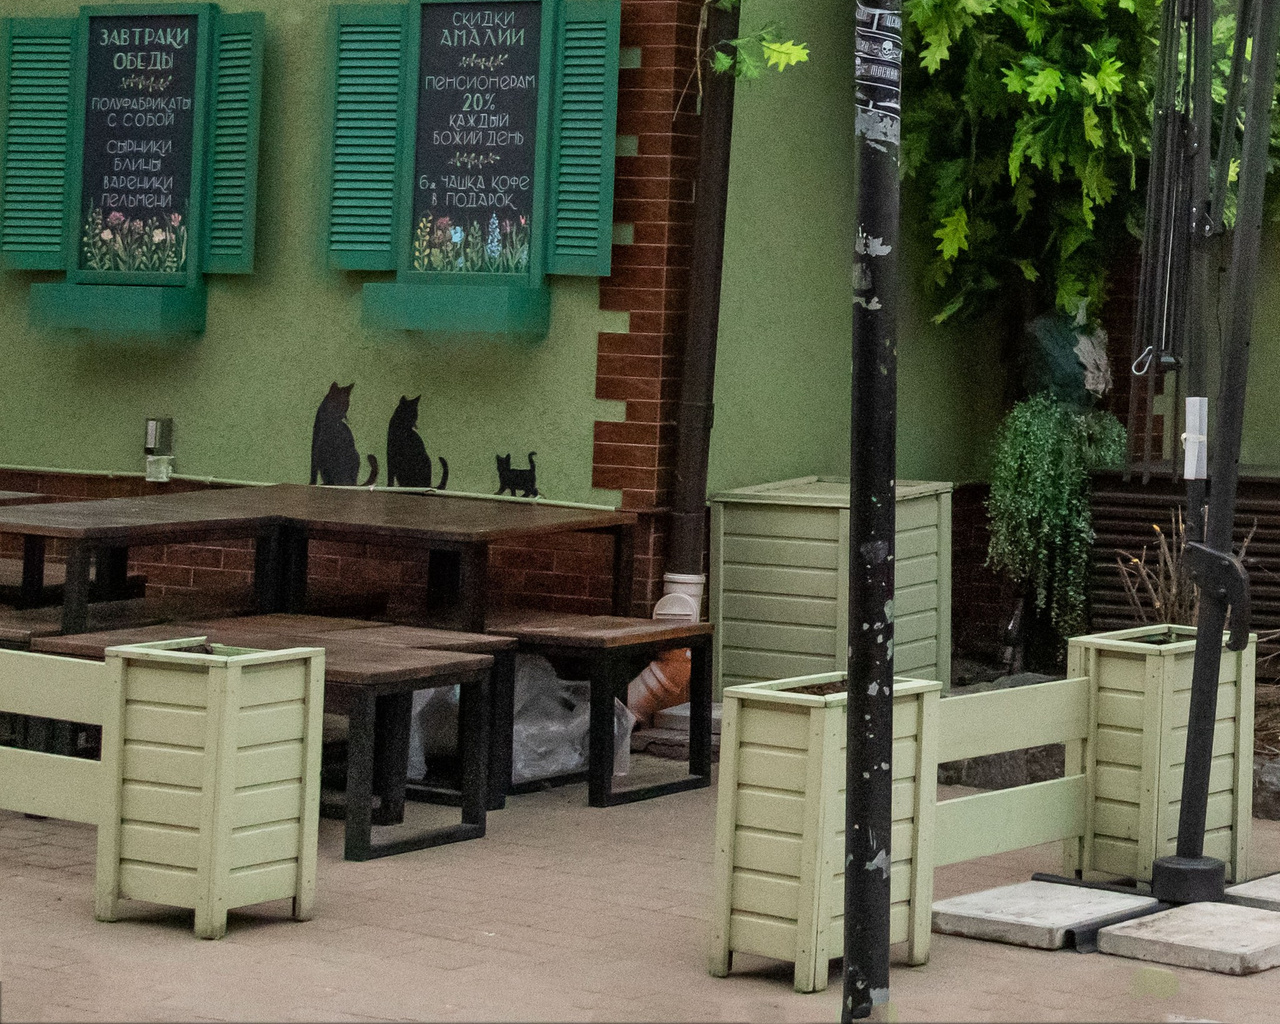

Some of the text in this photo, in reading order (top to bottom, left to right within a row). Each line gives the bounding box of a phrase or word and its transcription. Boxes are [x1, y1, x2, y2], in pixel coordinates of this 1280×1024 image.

[452, 11, 515, 27] СКИДКИ
[100, 28, 189, 49] ЗАВТРАКИ
[440, 29, 524, 46] АМАЛИИ
[113, 52, 173, 70] ОБЕДЫ
[91, 97, 191, 112] ПОЛУФАБРИКАТЫ
[462, 93, 495, 111] 20%
[123, 112, 174, 127] СОБОЙ
[450, 113, 509, 130] КАЖДЫЙ
[433, 131, 483, 146] БОЖИЙ
[107, 140, 171, 156] СЫРНИКИ
[114, 158, 161, 172] БЛИНЫ
[441, 176, 484, 191] ЧАШКА
[446, 192, 516, 209] ПОДАРОК
